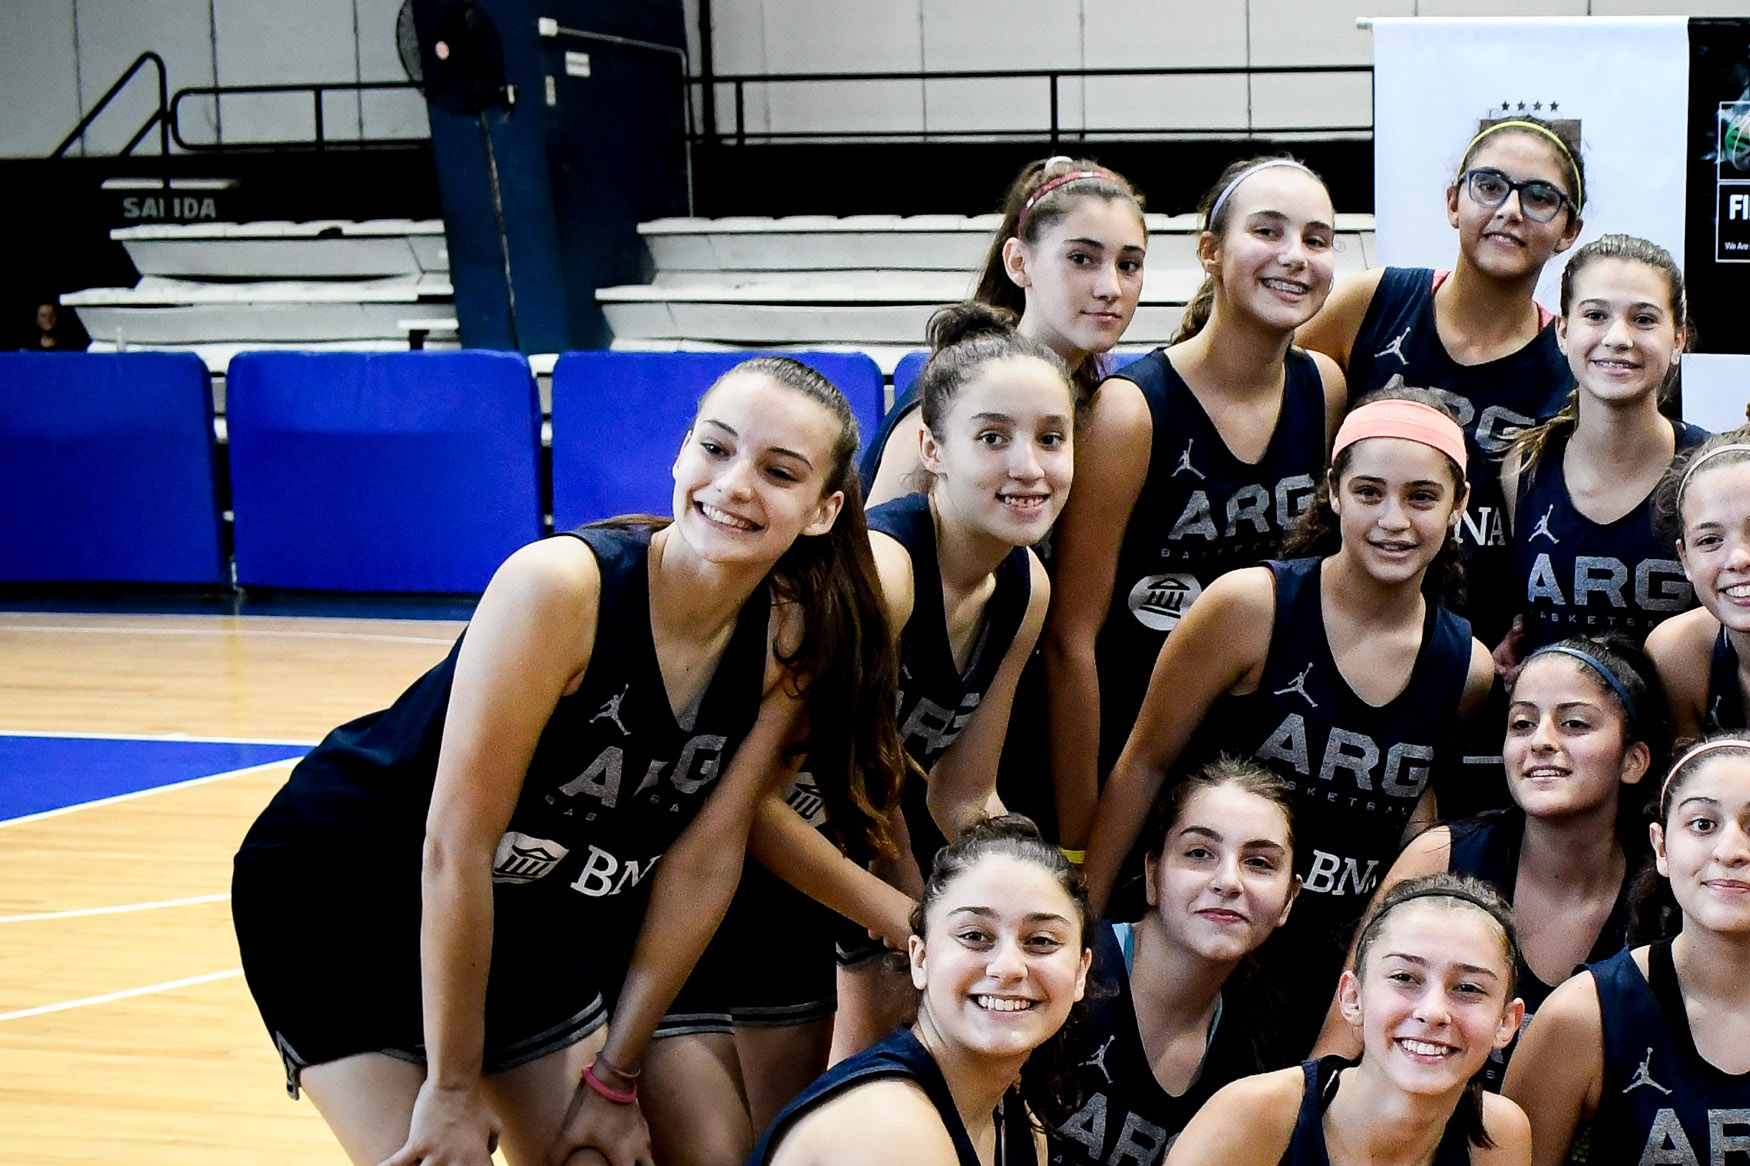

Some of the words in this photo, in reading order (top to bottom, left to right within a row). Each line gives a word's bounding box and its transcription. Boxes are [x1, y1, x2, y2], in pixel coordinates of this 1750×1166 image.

[1528, 553, 1693, 612] ARG
[1255, 713, 1434, 798] ARG
[570, 844, 664, 898] BN
